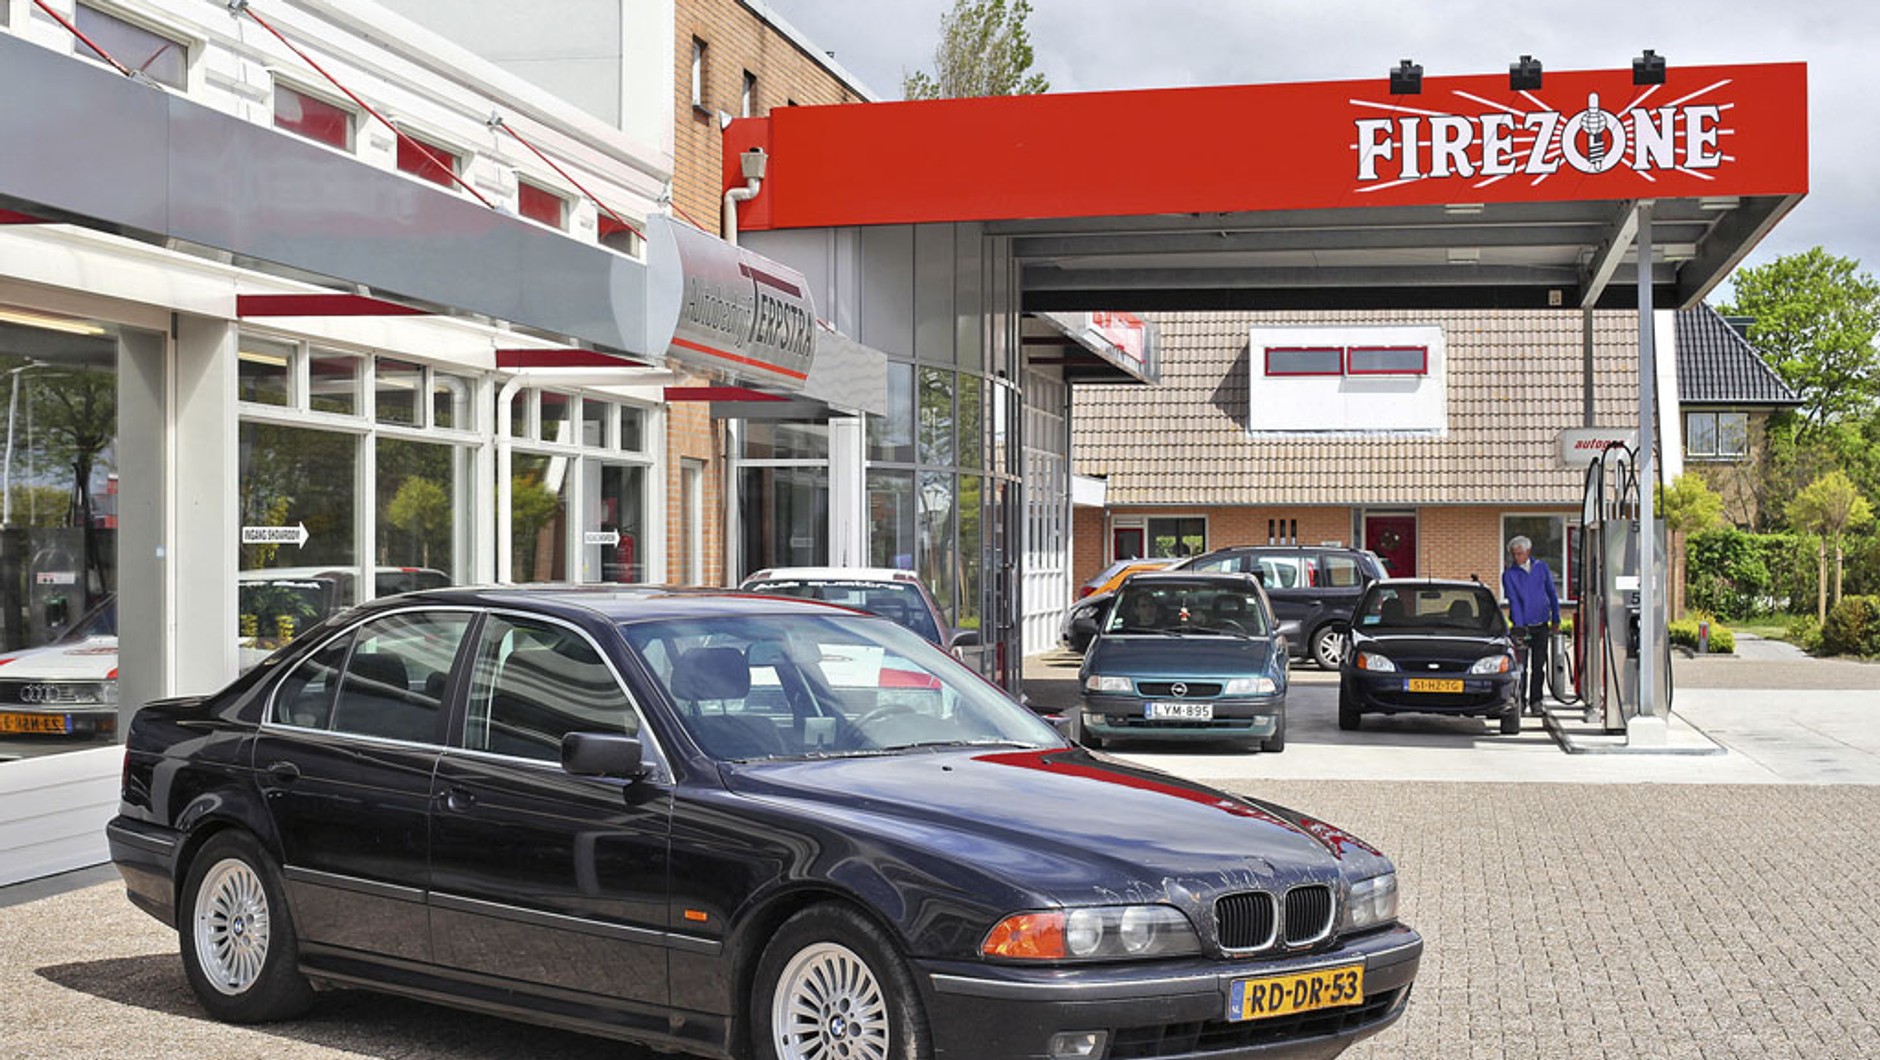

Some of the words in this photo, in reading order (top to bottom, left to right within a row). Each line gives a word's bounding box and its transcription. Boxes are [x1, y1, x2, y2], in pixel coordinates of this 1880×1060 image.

[1355, 102, 1722, 180] FIREZONE
[738, 261, 813, 357] TERPSTRA
[1250, 970, 1359, 1014] RD-DR-53
